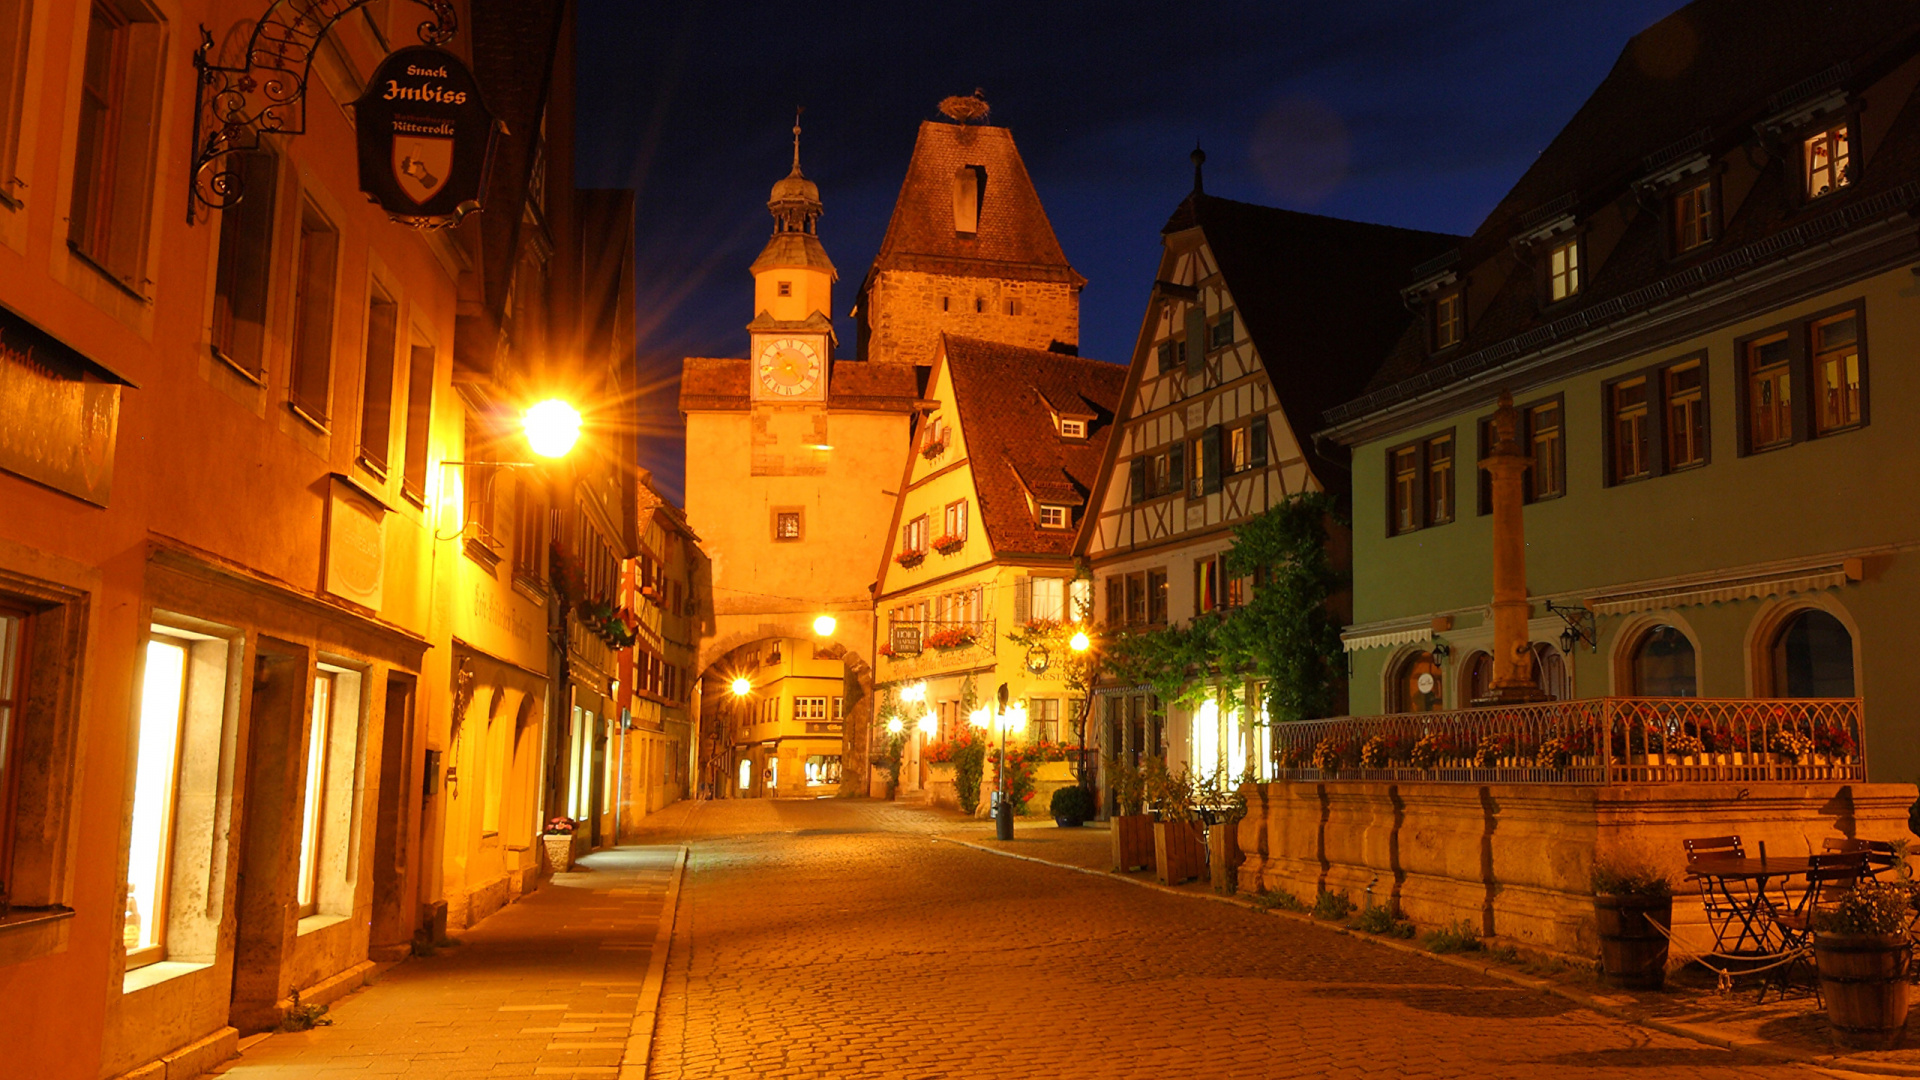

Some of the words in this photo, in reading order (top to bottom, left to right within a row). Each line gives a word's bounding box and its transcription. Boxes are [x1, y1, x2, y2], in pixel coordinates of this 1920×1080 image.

[407, 64, 448, 78] Snack
[383, 79, 467, 105] Imbiss
[392, 121, 455, 135] Ritterrolle
